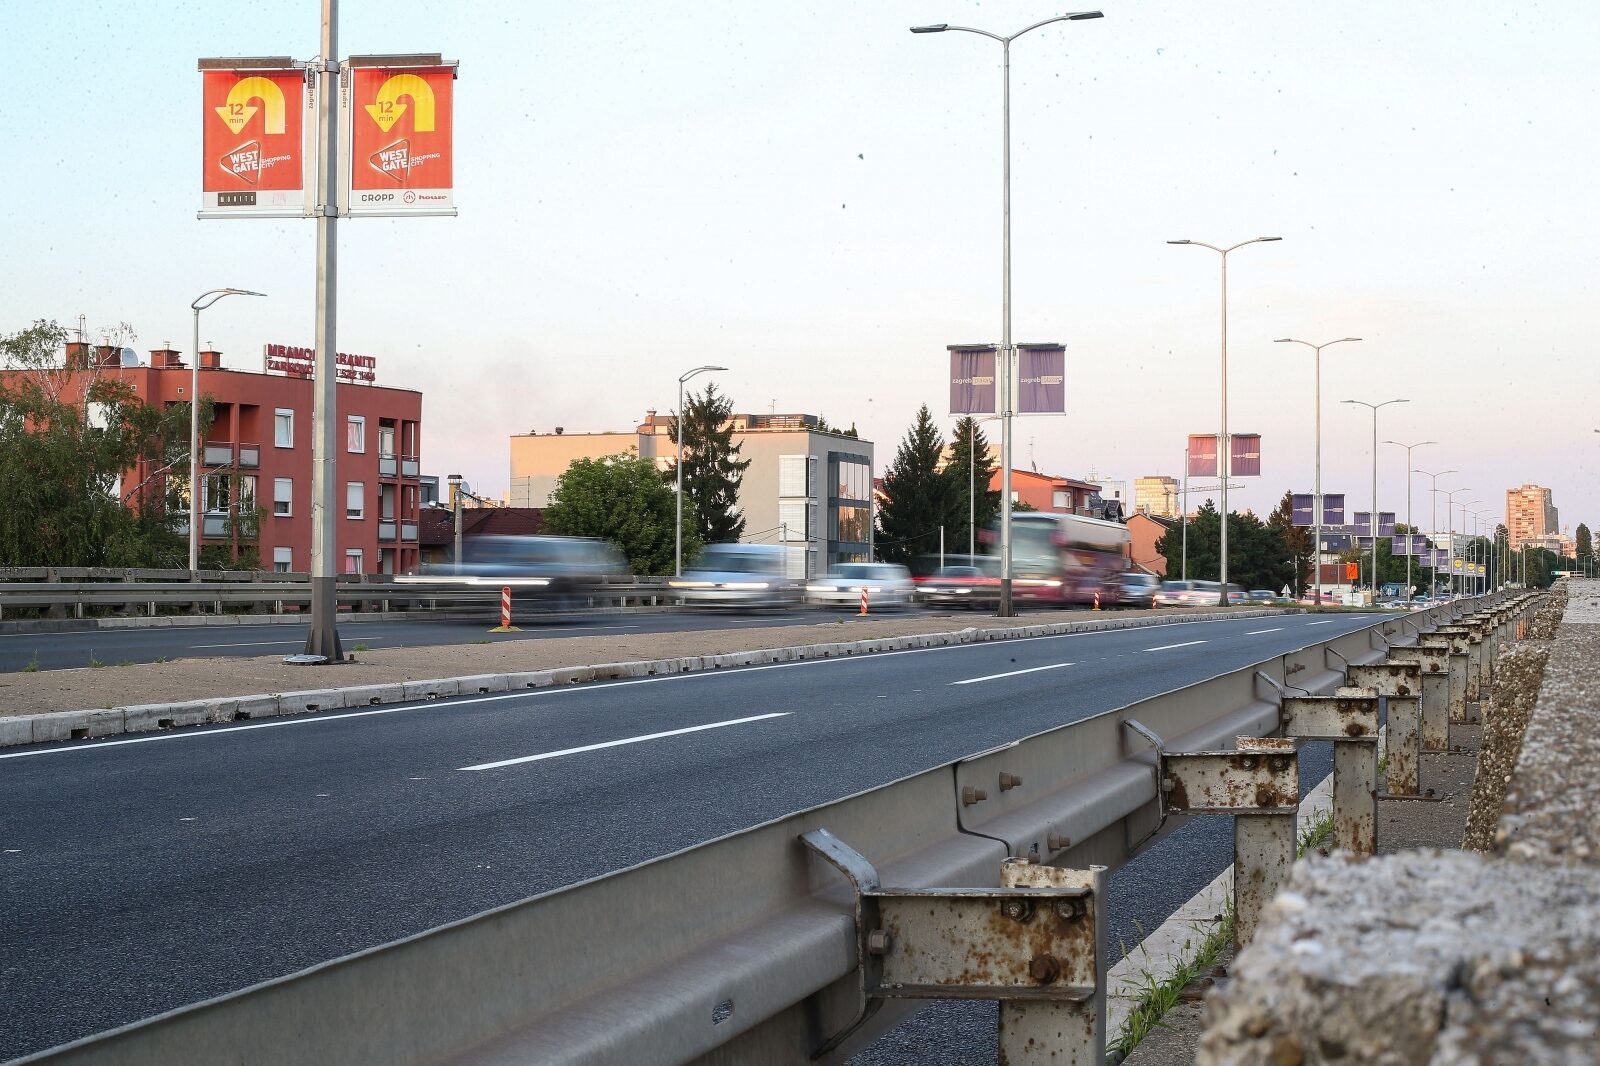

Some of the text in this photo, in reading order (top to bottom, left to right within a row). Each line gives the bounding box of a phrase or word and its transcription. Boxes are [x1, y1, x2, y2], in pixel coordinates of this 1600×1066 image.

[229, 103, 244, 115] 12
[378, 101, 393, 113] 12
[378, 114, 393, 122] min
[229, 151, 258, 164] WEST
[261, 154, 291, 164] SHOPPING
[379, 148, 407, 161] WEST
[410, 152, 441, 162] SHOPPING
[232, 160, 259, 173] GATE
[382, 158, 408, 171] GATE
[410, 159, 424, 167] CITY
[361, 193, 394, 202] CROPP
[952, 376, 973, 385] zagreb
[1020, 376, 1041, 385] zagreb
